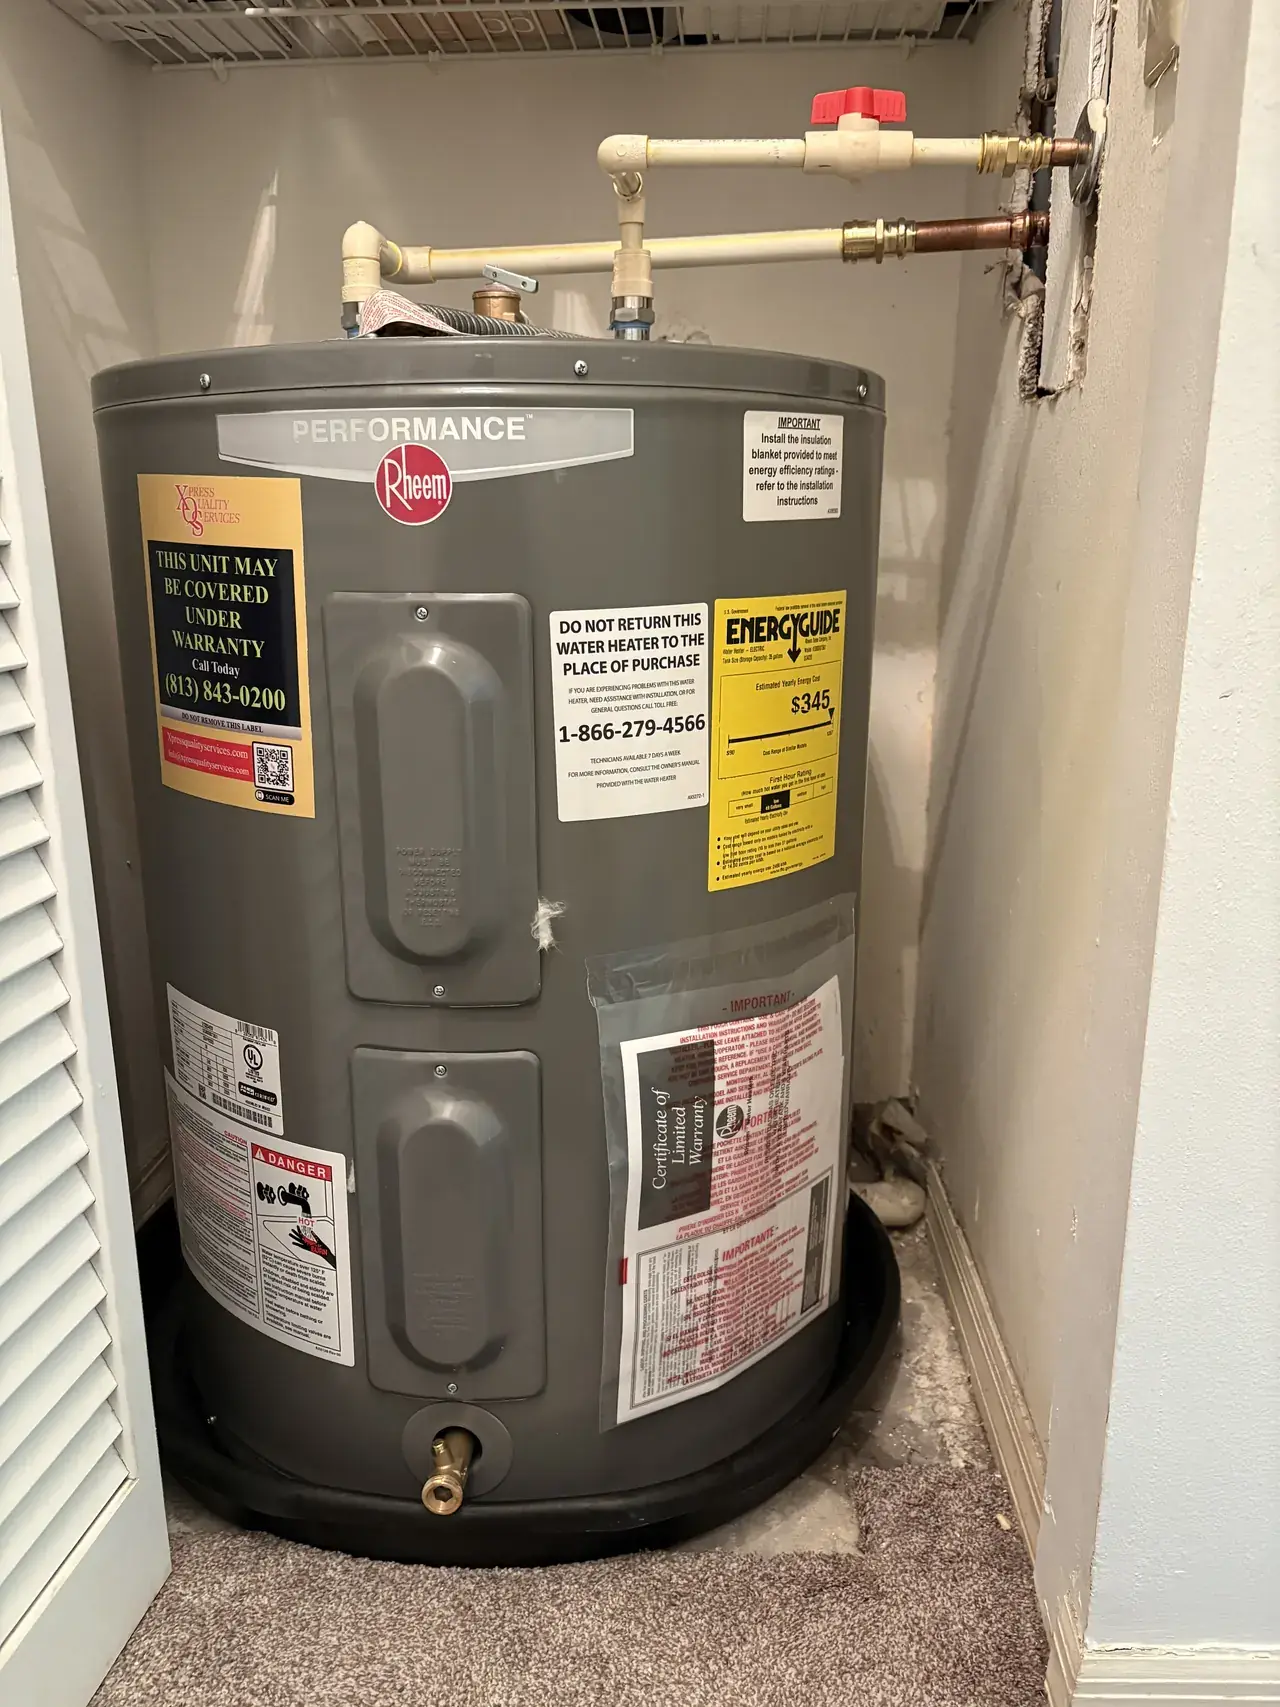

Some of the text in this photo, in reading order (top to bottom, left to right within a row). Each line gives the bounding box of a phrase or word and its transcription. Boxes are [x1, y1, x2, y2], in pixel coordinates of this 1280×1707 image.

[778, 417, 821, 430] IMPORTANT
[761, 433, 831, 445] Install the insulation
[752, 449, 837, 461] blanket provided to meet
[384, 445, 447, 511] Rheem
[749, 465, 835, 477] energy efficiency ratings
[756, 480, 833, 490] refer to the installation
[777, 495, 818, 506] instructions
[156, 550, 278, 577] THIS UNIT MAY
[164, 577, 269, 604] BE COVERED
[185, 606, 242, 629] UNDER
[560, 612, 701, 634] DO NOT RETURN THIS
[726, 608, 840, 645] ENERGYGUIDE
[172, 630, 265, 658] WARRANTY
[556, 633, 705, 655] WATER HEATER TO THE
[192, 658, 240, 679] Call Today
[563, 653, 700, 676] PLACE OF PURCHASE
[165, 672, 286, 712] (813) 843-0200
[596, 684, 631, 693] EXPERIENCING
[632, 682, 656, 690] PROBLEMS
[680, 678, 695, 686] WATER
[756, 680, 780, 690] Estimated
[782, 678, 796, 688] Yearly
[798, 677, 811, 685] Energy
[604, 694, 632, 703] ASSISTANCE
[614, 703, 641, 712] QUESTIONS
[791, 688, 830, 714] $345
[181, 712, 264, 733] DO NOT REMOVE THIS LABEL
[559, 713, 706, 743] 1-866-279-4566
[590, 755, 622, 764] TECHNICIANS
[623, 753, 647, 761] AVAILABLE
[668, 749, 681, 757] WEEK
[630, 765, 651, 773] CONSULT
[681, 759, 700, 767] MANUAL
[596, 780, 621, 788] PROVIDED
[660, 774, 677, 782] HEATER
[783, 772, 796, 781] Hour
[797, 769, 812, 778] Rating
[730, 991, 790, 1013] IMPORTANT
[680, 1021, 767, 1044] INSTALLATION INSTRUCTIONS AND
[724, 1036, 740, 1044] LEAVE
[741, 1030, 767, 1041] ATTACHED
[717, 1070, 737, 1081] SERVICE
[224, 1130, 248, 1145] CAUTION
[651, 1086, 671, 1190] Certificate of
[672, 1106, 686, 1164] Limited
[689, 1095, 708, 1166] Warranty
[268, 1153, 326, 1179] DANGER
[298, 1216, 315, 1226] HOT
[722, 1226, 775, 1262] IMPORTANTE
